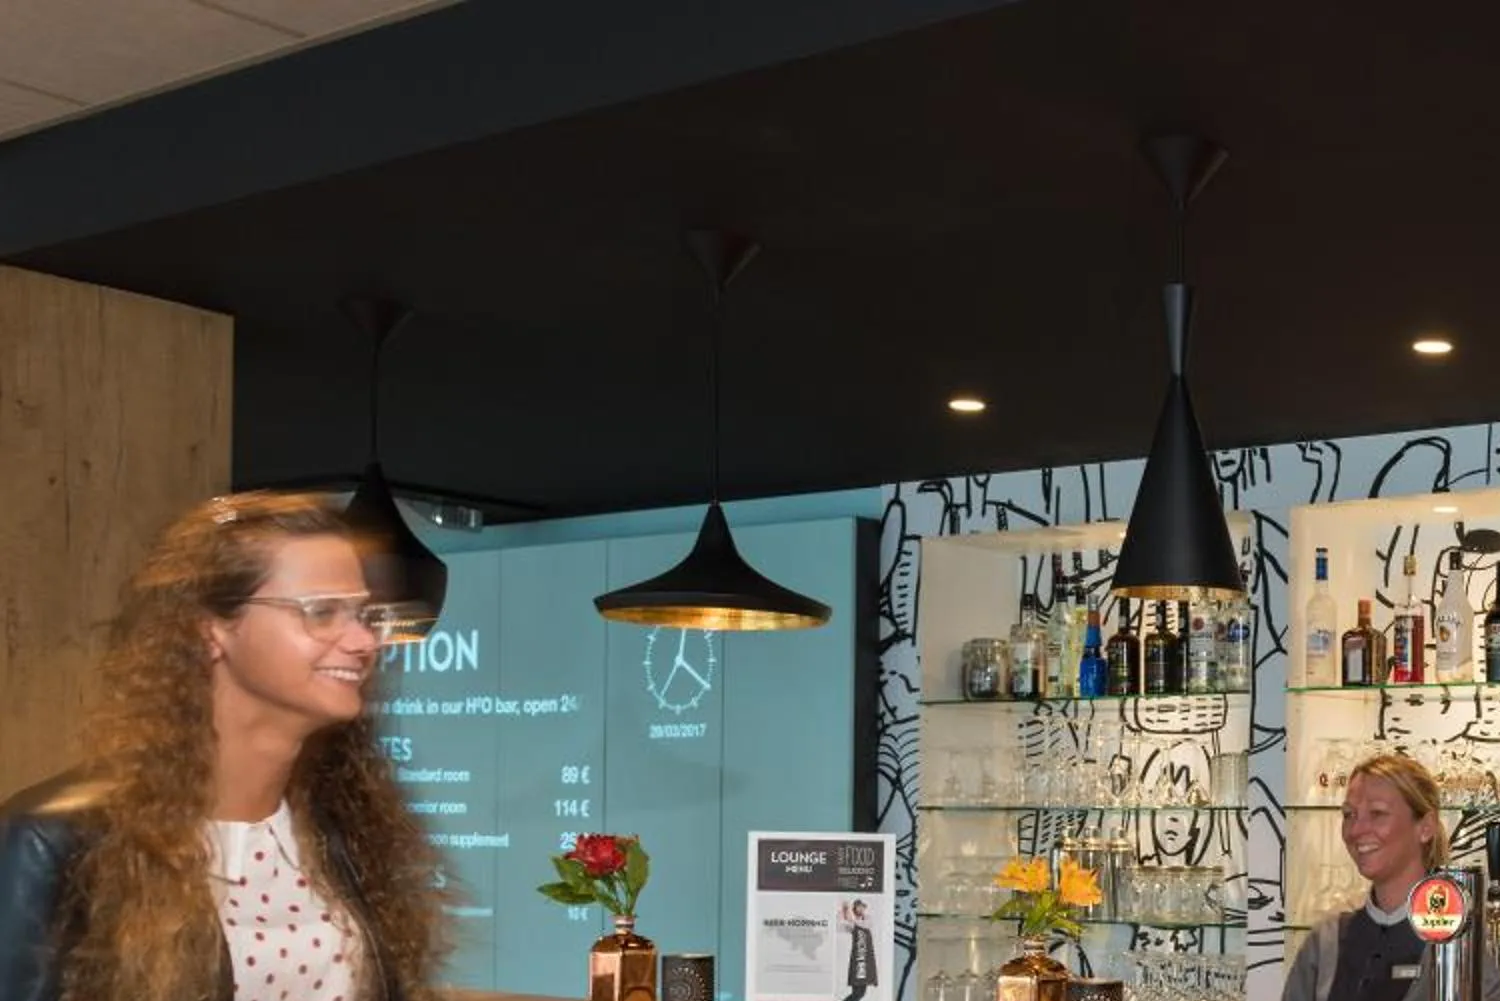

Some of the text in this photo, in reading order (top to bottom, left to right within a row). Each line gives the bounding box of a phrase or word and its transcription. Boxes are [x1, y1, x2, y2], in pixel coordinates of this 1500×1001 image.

[392, 697, 424, 714] drink
[426, 698, 439, 714] in
[441, 701, 464, 714] our
[523, 699, 557, 717] open
[443, 771, 470, 782] room
[561, 766, 578, 784] 89
[580, 766, 590, 784] €
[439, 803, 467, 814] room
[554, 800, 577, 817] 114
[580, 800, 590, 817] €
[771, 851, 828, 865] LOUNGE
